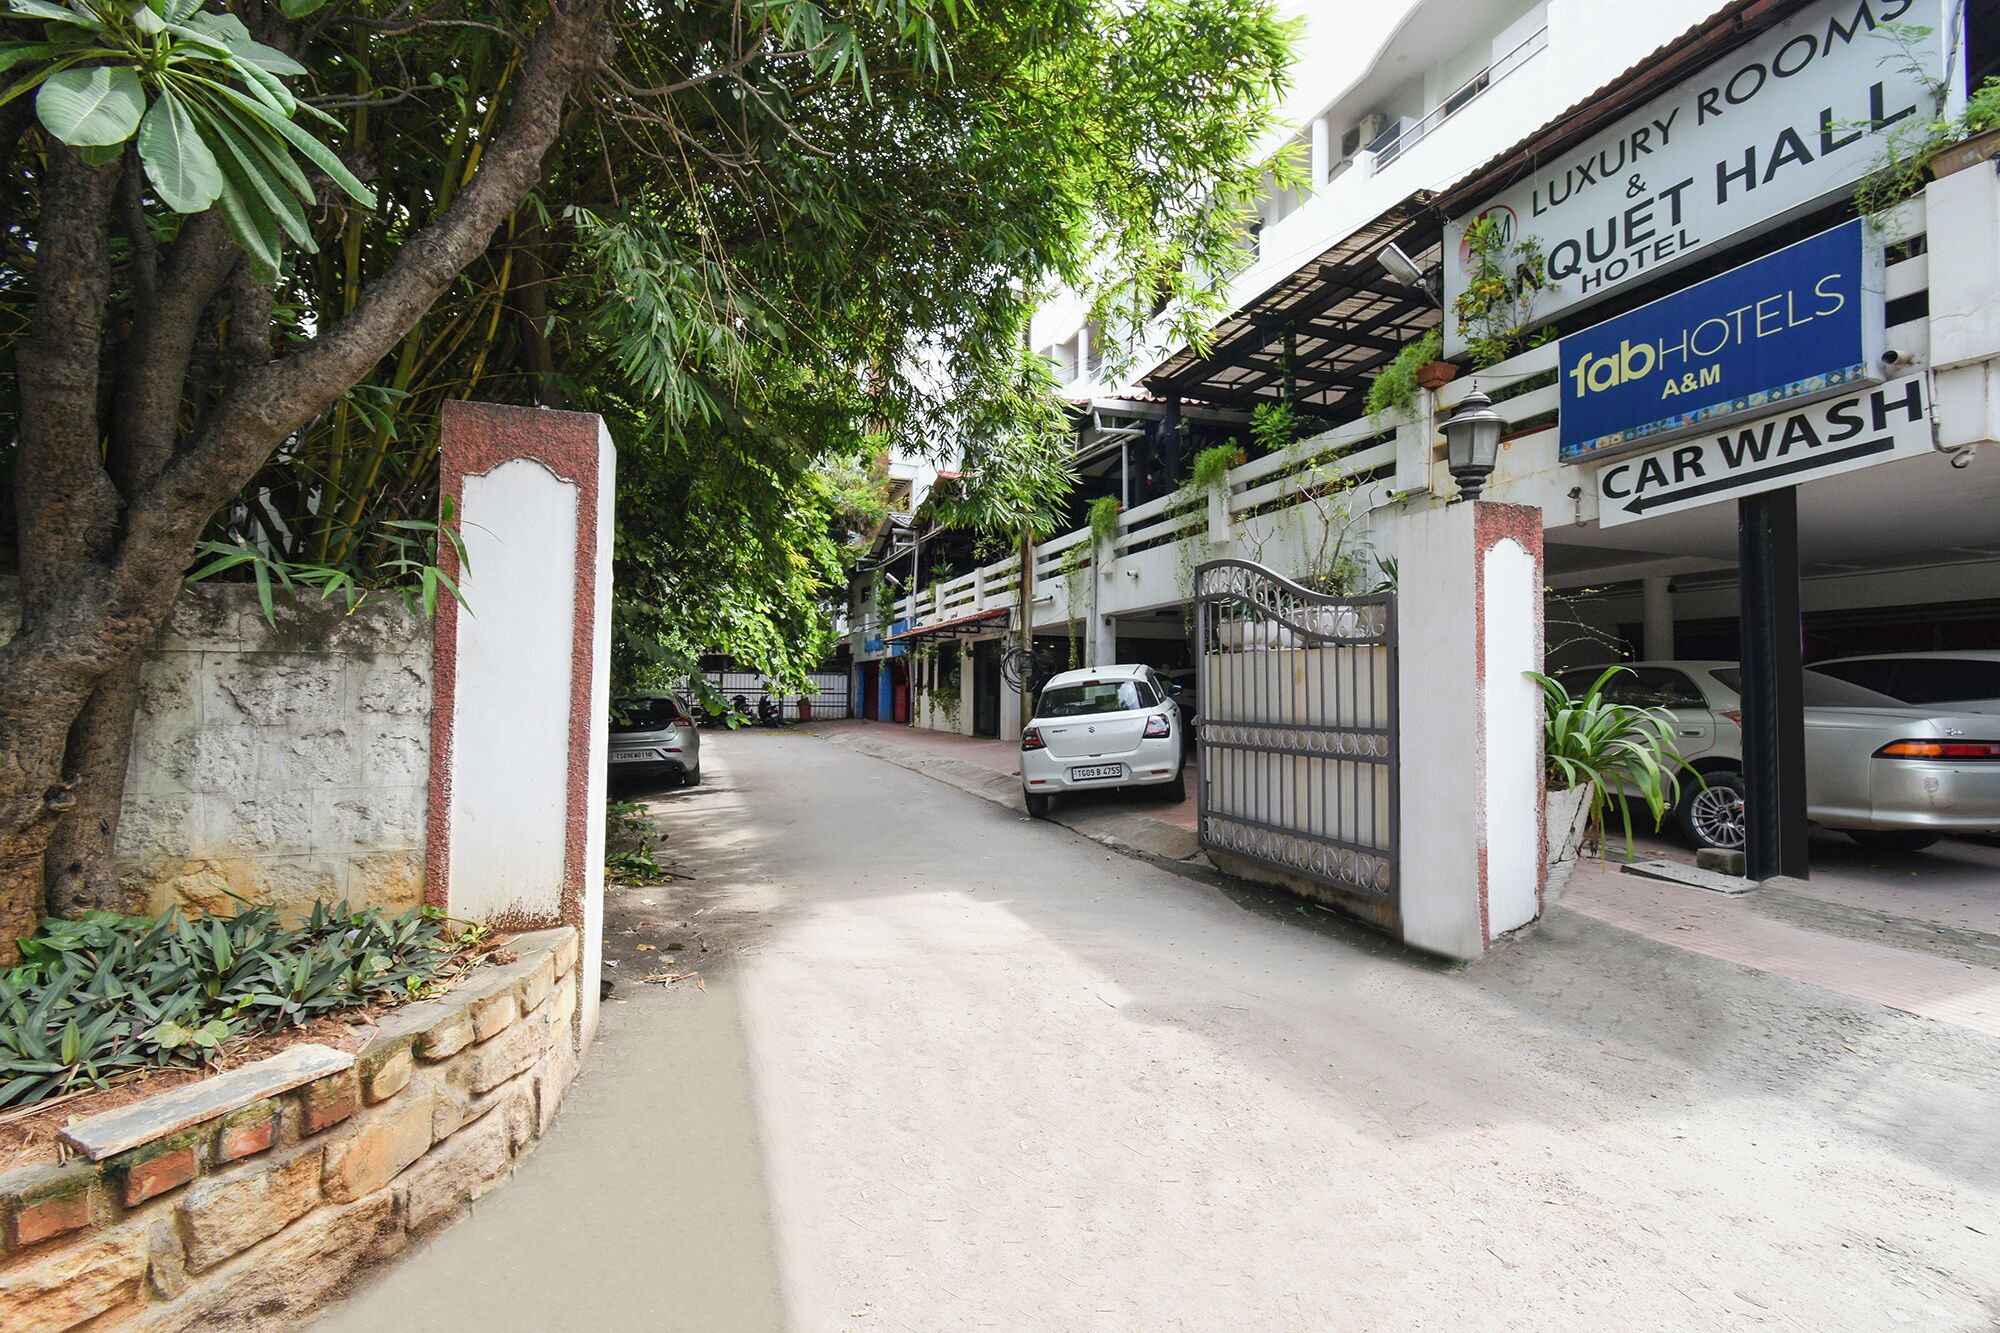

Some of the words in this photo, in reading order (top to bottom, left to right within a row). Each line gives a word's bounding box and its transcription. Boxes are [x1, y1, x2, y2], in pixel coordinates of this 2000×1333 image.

[1532, 107, 1680, 218] LUXURY
[1625, 173, 1647, 199] &
[1716, 81, 1917, 206] HALL
[1582, 229, 1700, 294] HOTEL
[1661, 364, 1721, 400] A&M
[1601, 446, 1706, 500] CAR
[1717, 379, 1923, 469] WASH
